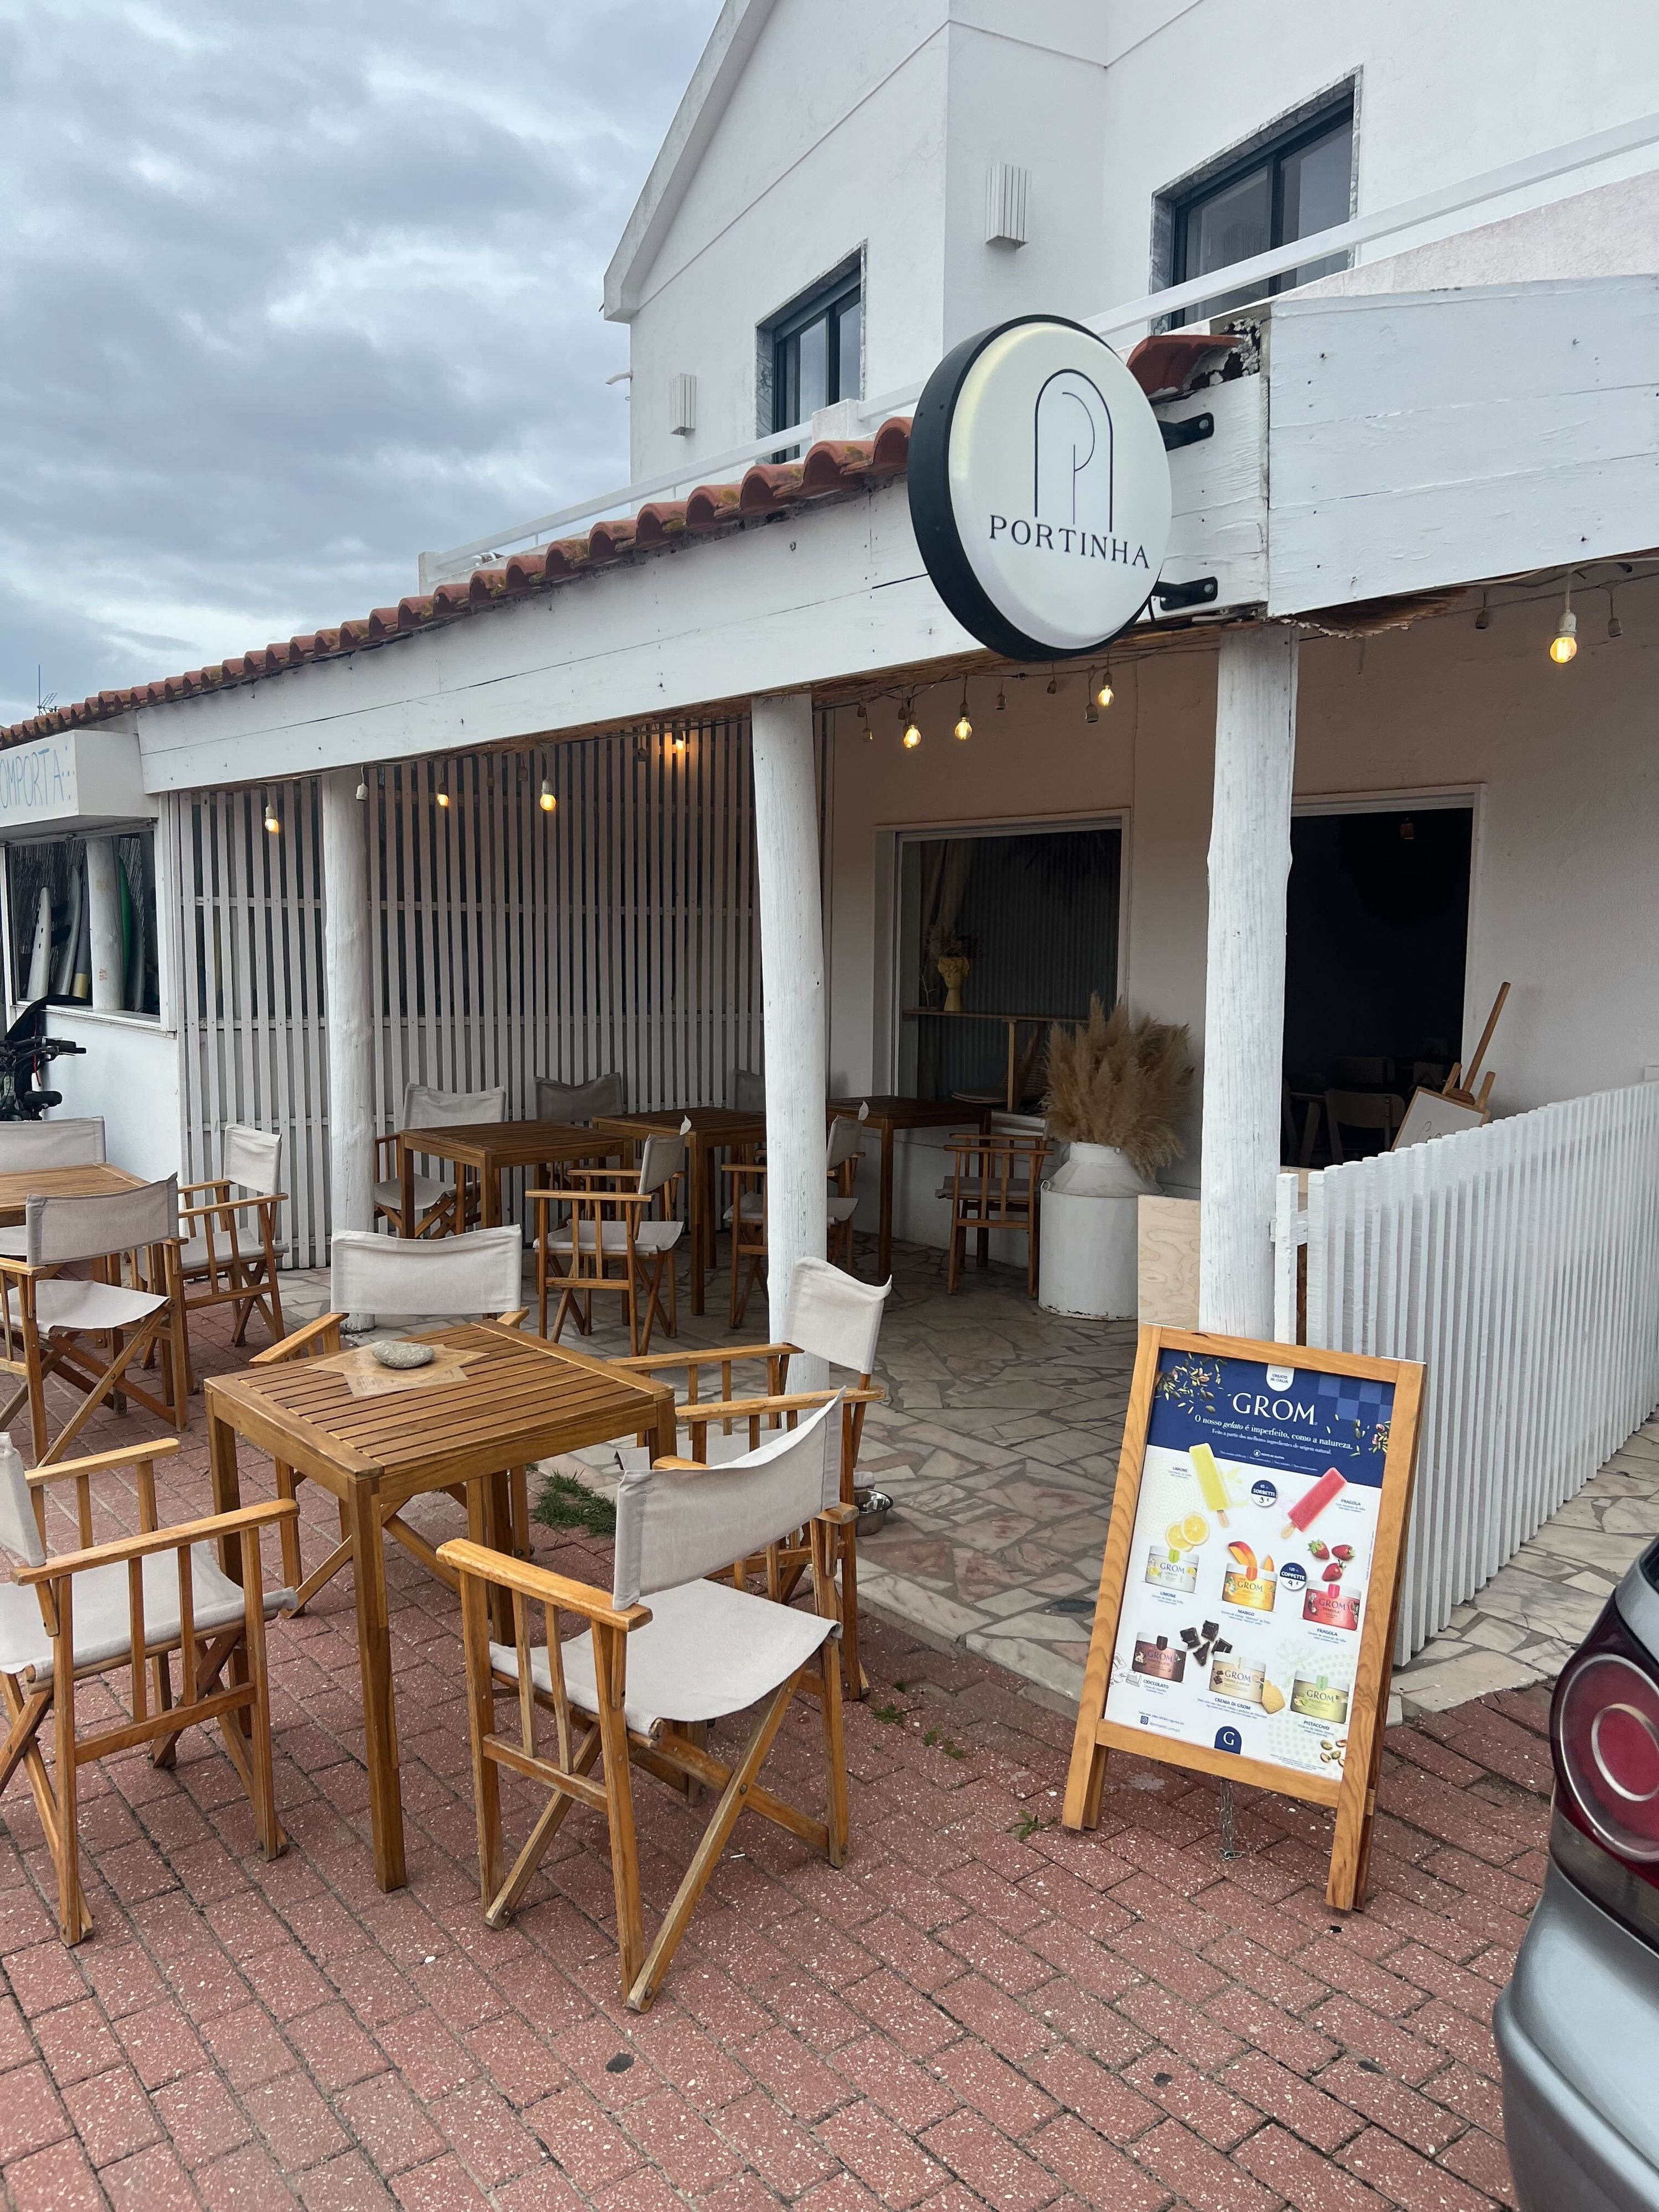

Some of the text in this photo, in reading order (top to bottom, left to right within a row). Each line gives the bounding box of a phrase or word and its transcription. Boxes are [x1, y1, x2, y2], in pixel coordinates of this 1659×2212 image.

[989, 514, 1150, 570] PORTINHA
[1233, 1392, 1314, 1425] GROM
[1194, 1414, 1201, 1422] O
[1202, 1417, 1222, 1426] nosso
[1222, 1421, 1244, 1430] gelato
[1251, 1425, 1290, 1439] imperfeito,
[1291, 1433, 1311, 1442] como
[1319, 1438, 1353, 1450] natureza.
[1253, 1488, 1275, 1497] SORBETTI
[1160, 1562, 1185, 1574] GROM
[1281, 1571, 1305, 1581] COPPETTE
[1237, 1580, 1264, 1593] GROM
[1318, 1598, 1346, 1611] GROM
[1317, 1627, 1338, 1636] FRAGOLA
[1147, 1650, 1173, 1663] GROM
[1224, 1670, 1251, 1683] GROM
[1143, 1679, 1169, 1689] CIOCCOLATO
[1306, 1689, 1334, 1703] GROM
[1303, 1720, 1330, 1730] PISTACCHIO
[1223, 1731, 1235, 1746] G
